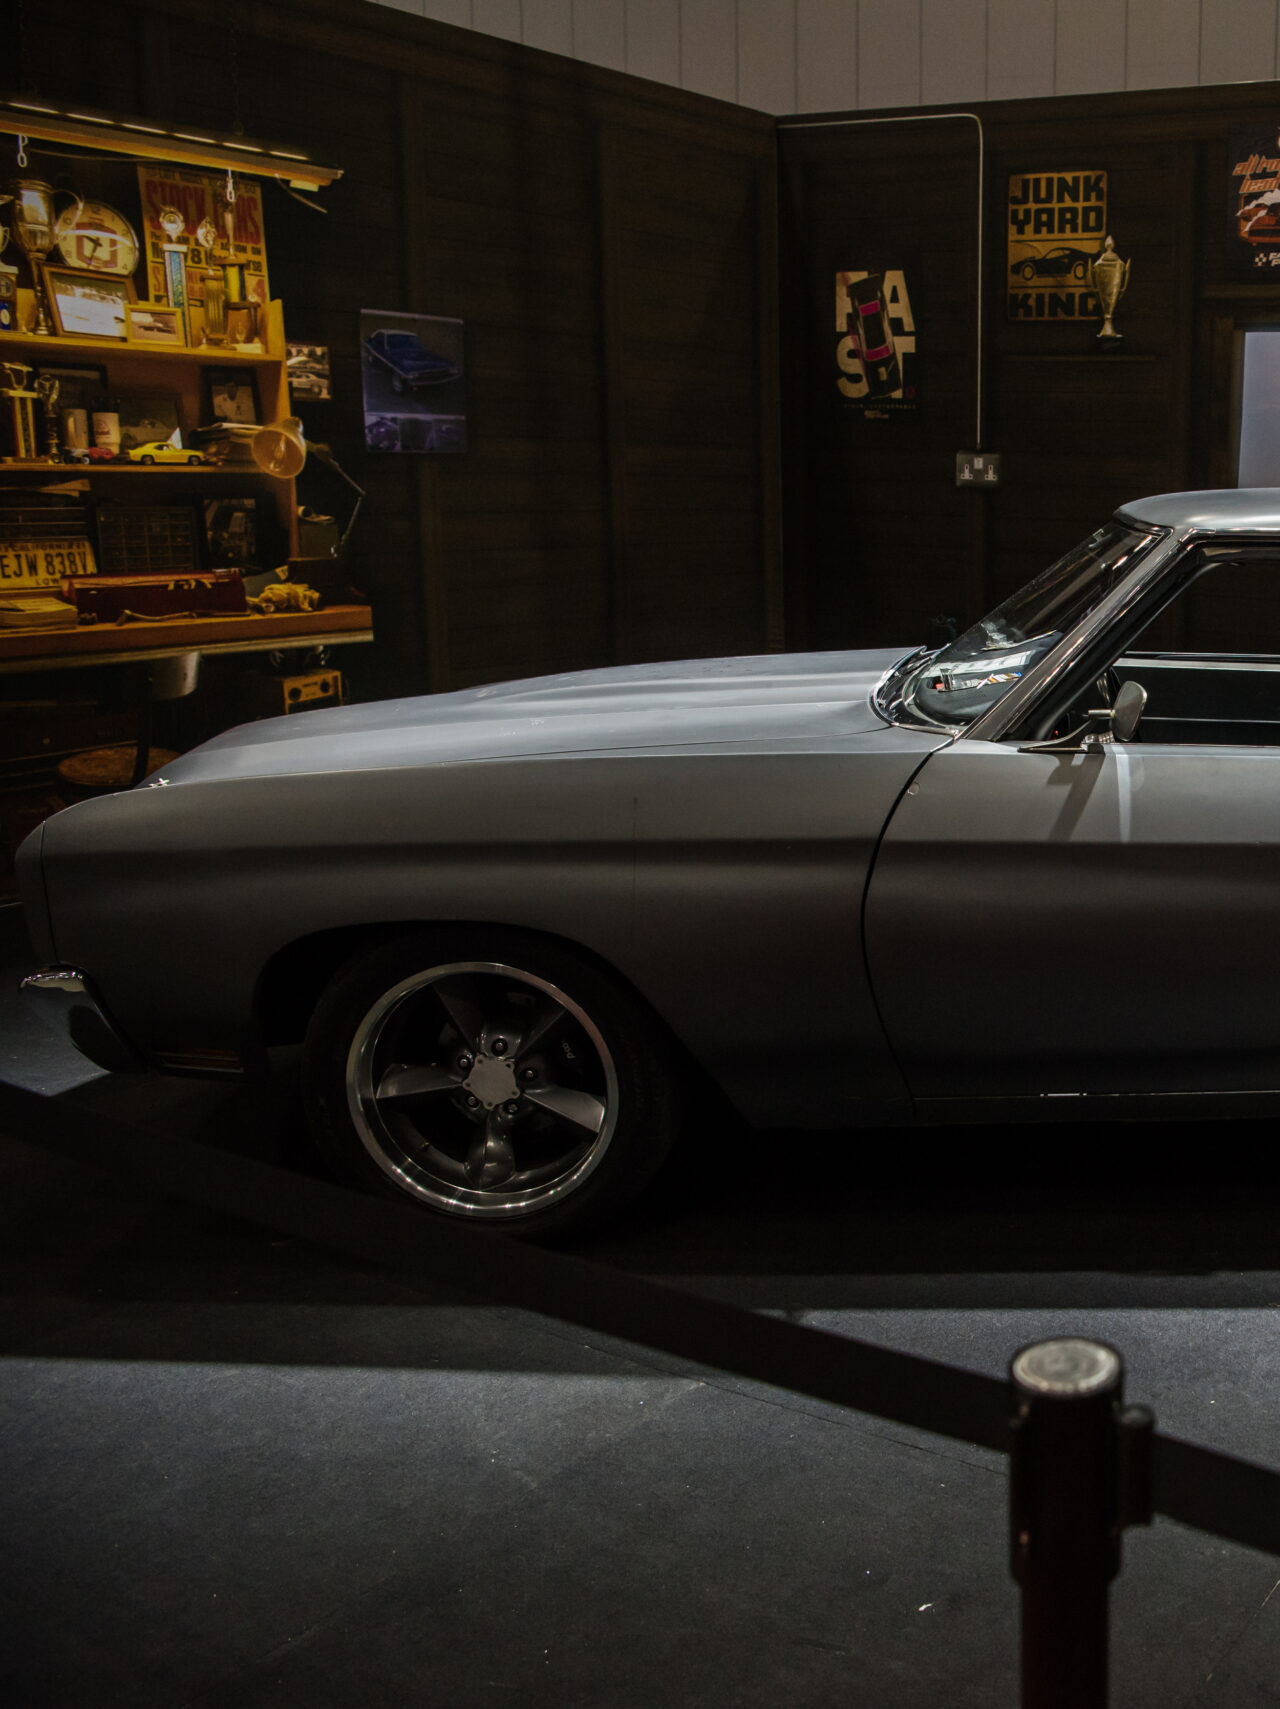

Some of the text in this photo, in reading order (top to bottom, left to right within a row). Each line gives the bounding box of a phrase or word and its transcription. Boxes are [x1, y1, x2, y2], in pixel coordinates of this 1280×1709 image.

[1010, 175, 1104, 205] JUNK
[1011, 206, 1103, 235] YARD
[1009, 292, 1102, 317] KING
[0, 553, 39, 578] EJW
